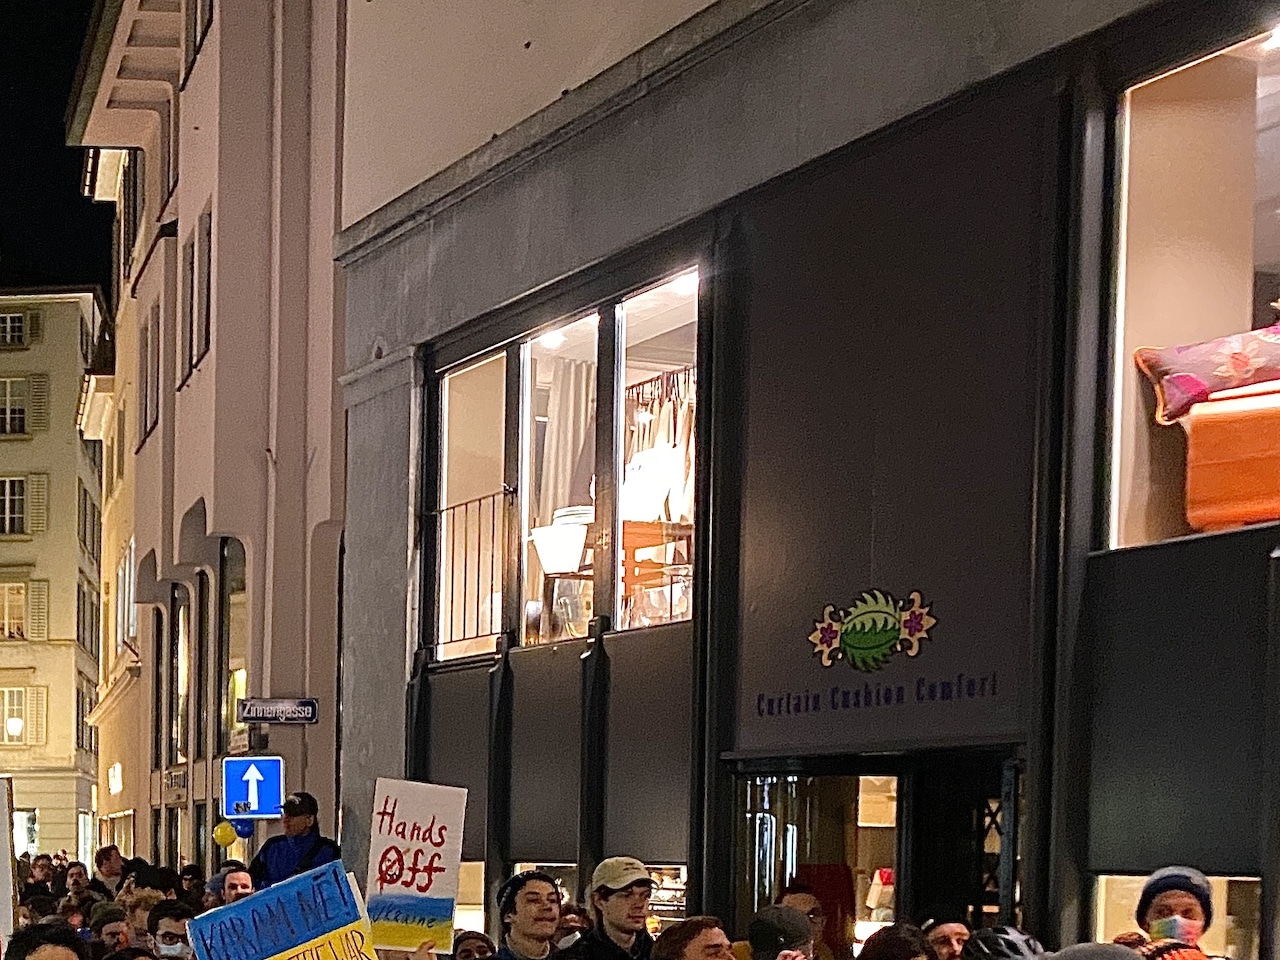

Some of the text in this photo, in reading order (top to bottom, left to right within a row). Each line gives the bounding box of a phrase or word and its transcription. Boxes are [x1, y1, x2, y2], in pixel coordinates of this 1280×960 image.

[829, 681, 905, 710] Cushion
[916, 672, 998, 702] Comfort
[242, 701, 313, 721] Zinnengasse
[376, 795, 448, 848] Hands
